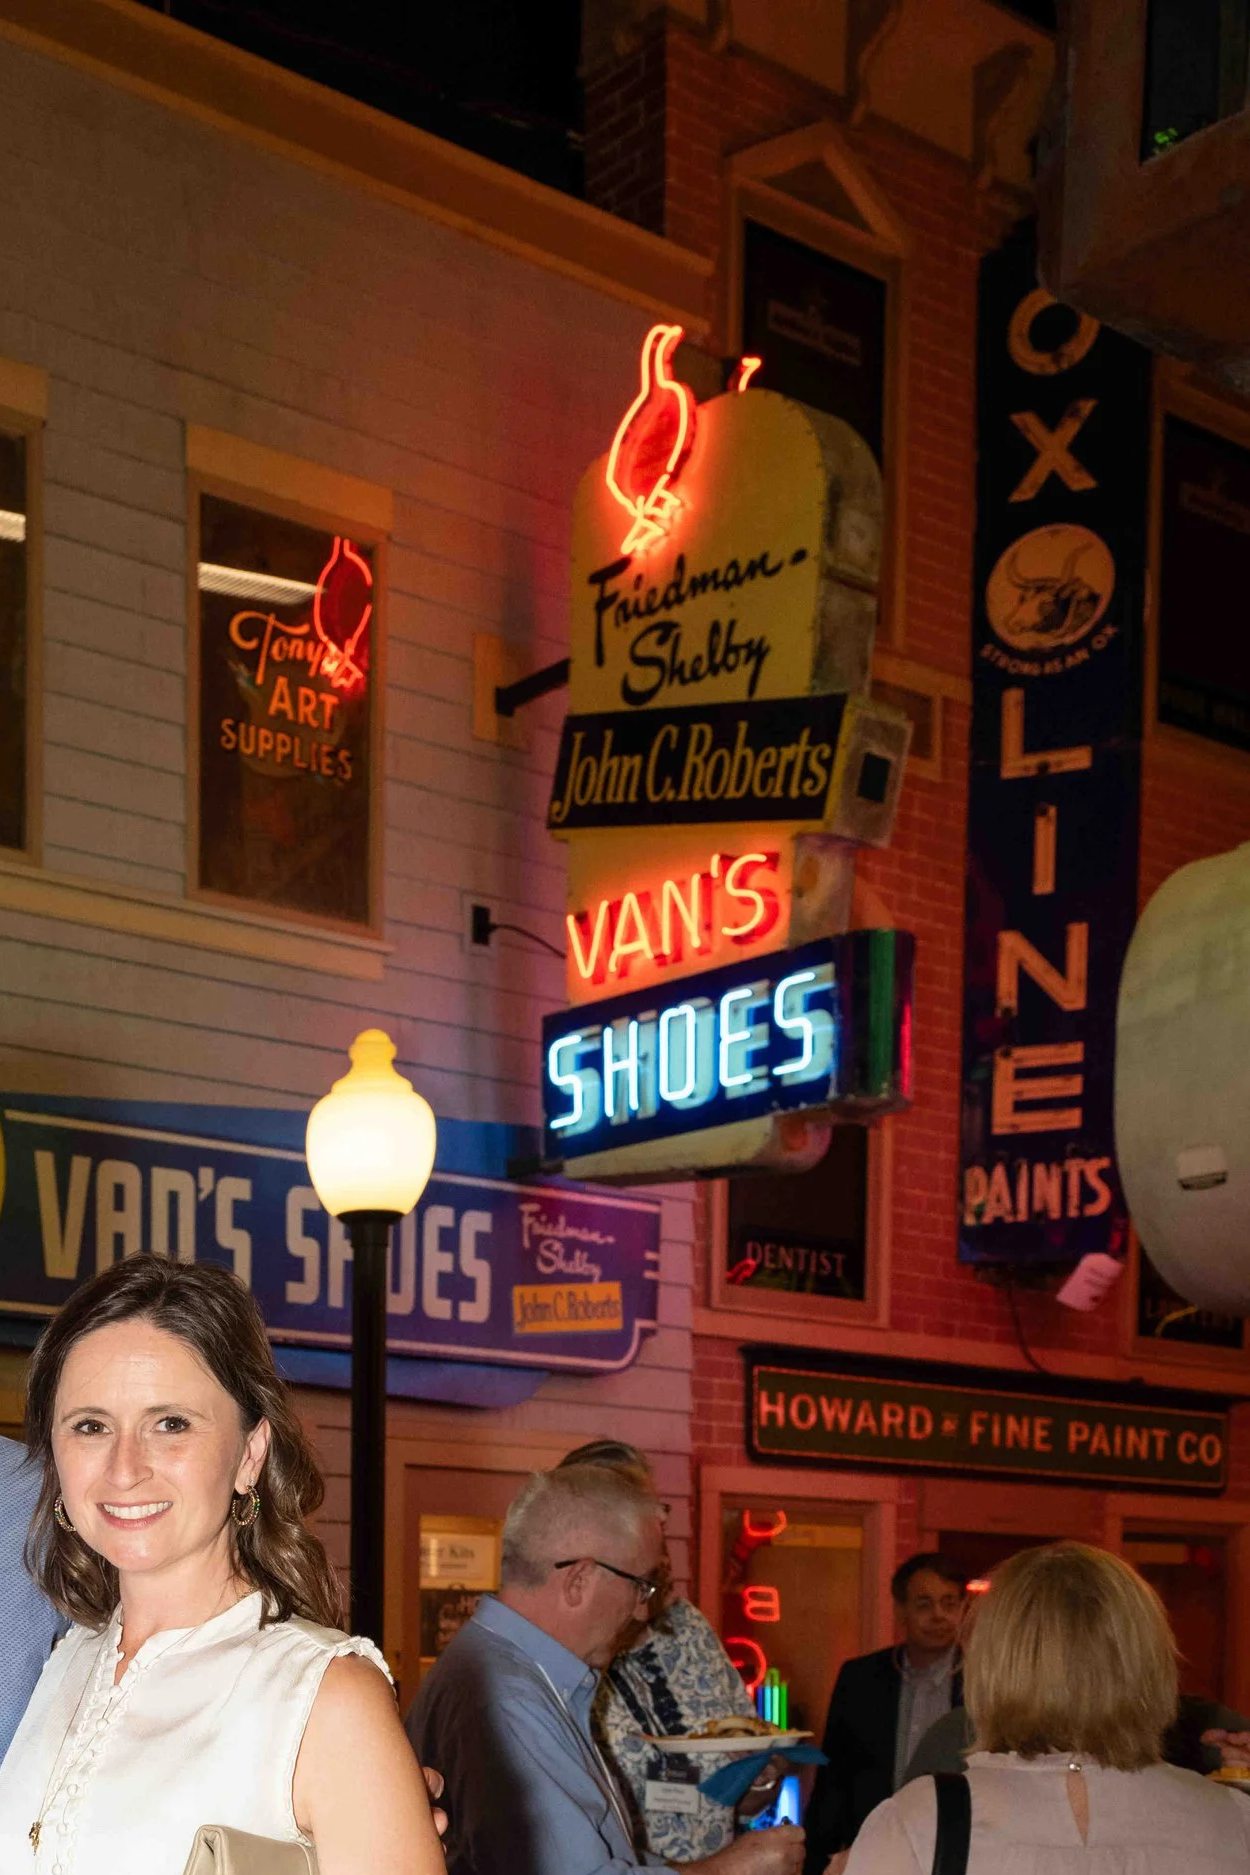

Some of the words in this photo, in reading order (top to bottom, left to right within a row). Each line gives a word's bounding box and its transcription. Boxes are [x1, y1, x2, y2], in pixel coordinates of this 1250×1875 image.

[622, 618, 771, 706] Shelby
[979, 642, 1042, 677] STRONG
[1044, 657, 1063, 676] AS
[1064, 647, 1090, 668] AN
[1091, 624, 1119, 651] OX
[268, 676, 339, 732] ART
[221, 718, 352, 780] SUPPLIES
[551, 729, 643, 823] John
[567, 852, 780, 985] VAN'S
[548, 962, 836, 1139] SHOES
[34, 1150, 252, 1288] VAN'S
[962, 1157, 1111, 1226] PAINTS
[746, 1242, 847, 1278] DENTIST
[759, 1390, 934, 1441] HOWARD
[970, 1411, 1052, 1451] FINE
[1068, 1420, 1170, 1462] PAINT
[1177, 1431, 1223, 1467] CO
